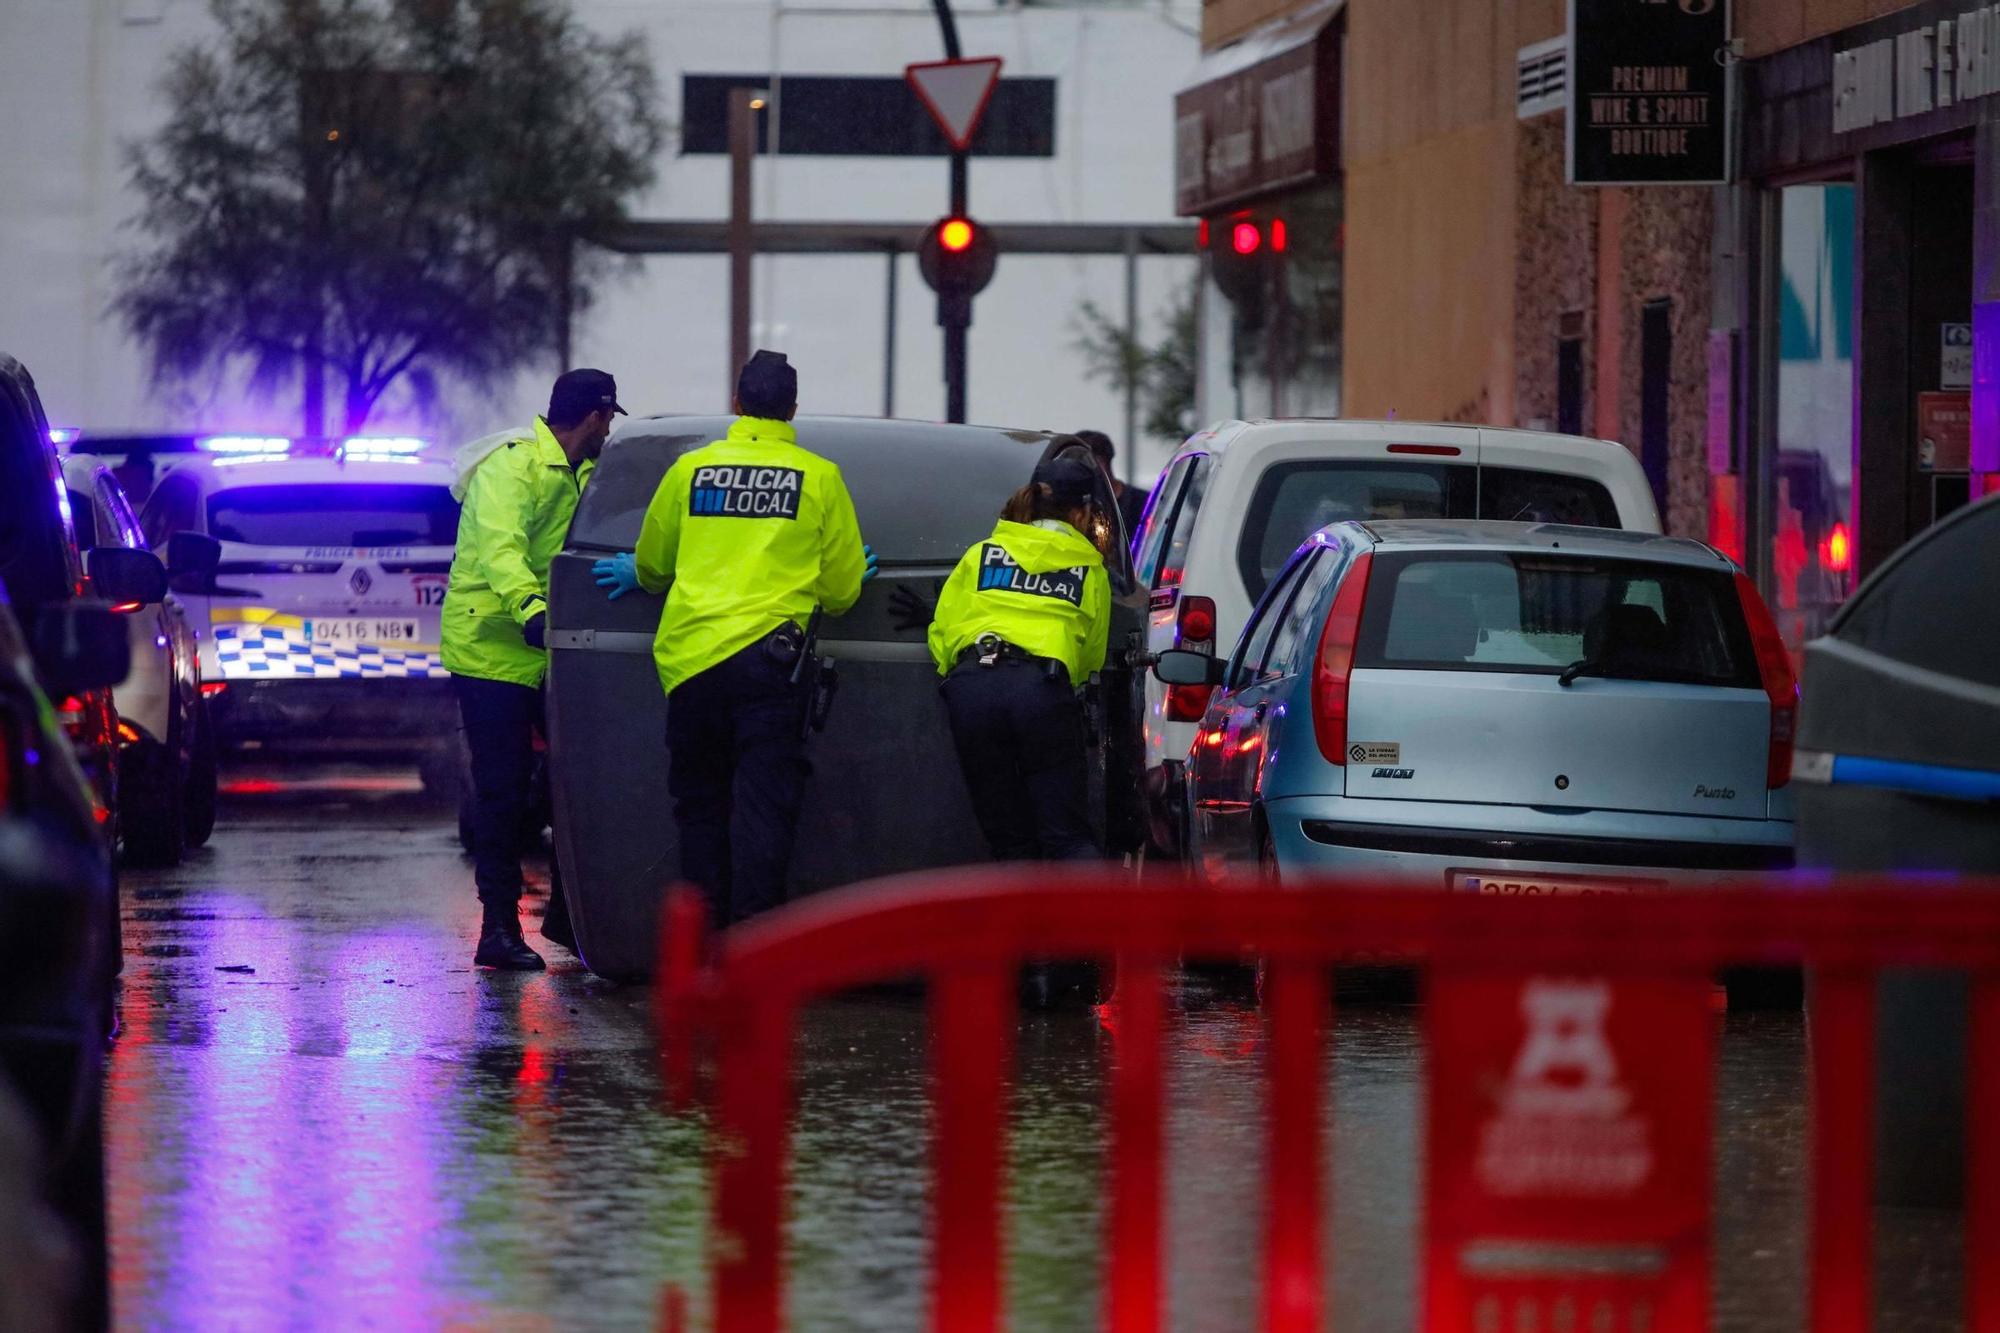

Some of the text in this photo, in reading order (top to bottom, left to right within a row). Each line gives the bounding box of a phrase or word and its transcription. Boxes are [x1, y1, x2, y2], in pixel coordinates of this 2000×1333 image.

[1612, 66, 1688, 91] PREMIUM
[1591, 98, 1708, 123] WINE & SPIRIT
[1611, 129, 1688, 156] BOUTIQUE
[694, 467, 798, 491] POLICIA
[723, 490, 793, 514] LOCAL
[415, 586, 445, 606] 112
[317, 621, 367, 639] 0416
[1372, 768, 1414, 779] FIAT
[1692, 784, 1736, 800] Punto
